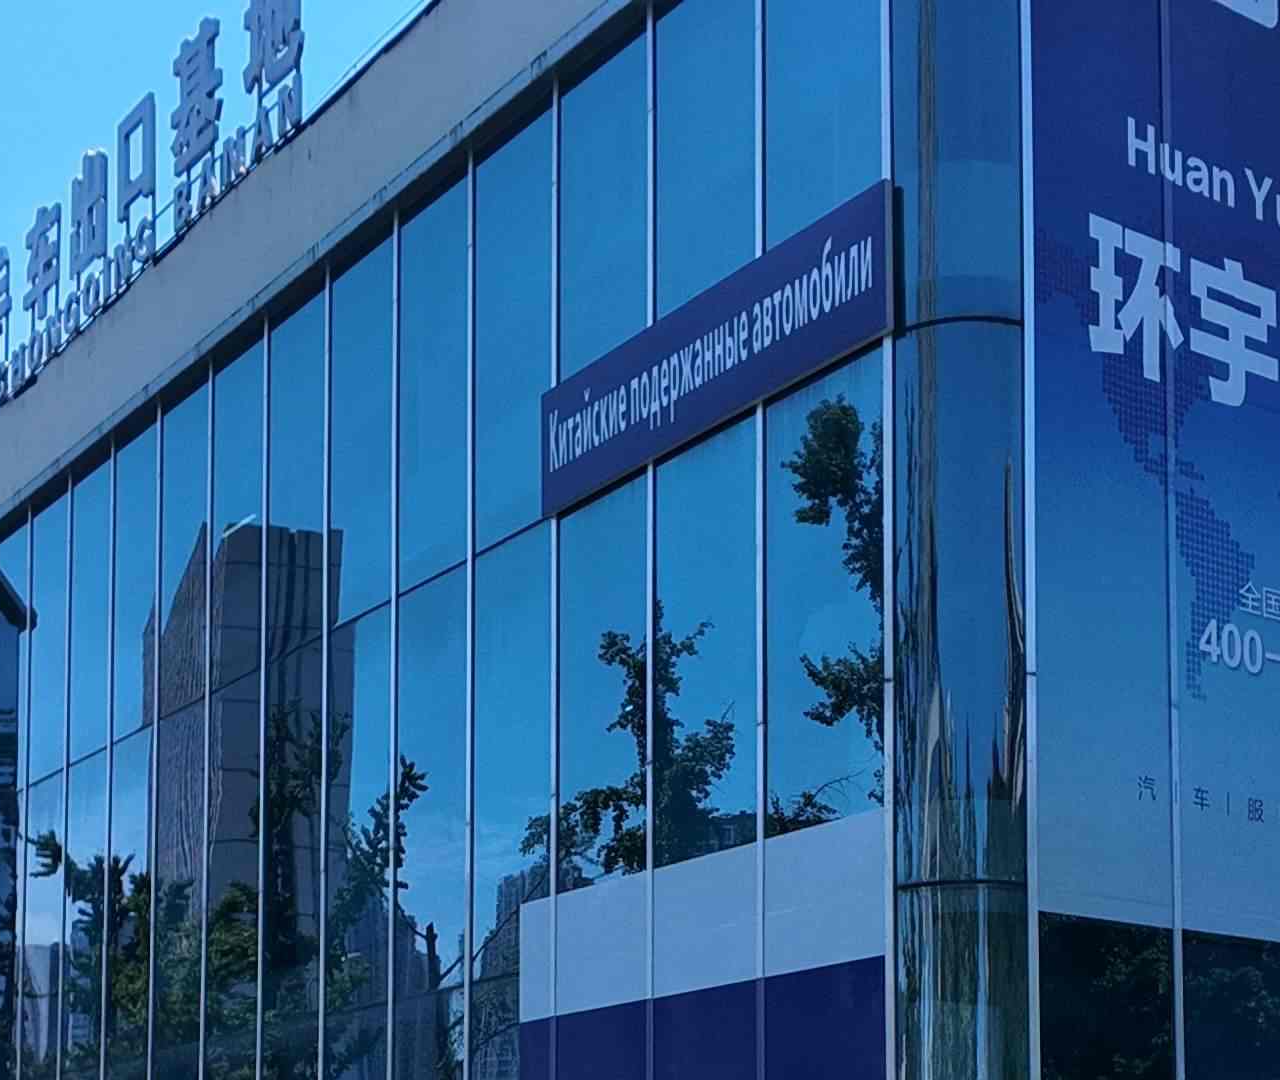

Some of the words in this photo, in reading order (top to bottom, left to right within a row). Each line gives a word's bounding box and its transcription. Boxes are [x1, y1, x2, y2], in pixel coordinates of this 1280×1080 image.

[174, 71, 304, 233] BANAN
[1127, 115, 1235, 209] Huan
[549, 384, 626, 474] Китайские
[629, 309, 749, 431] подержанные
[751, 235, 873, 355] автомобили
